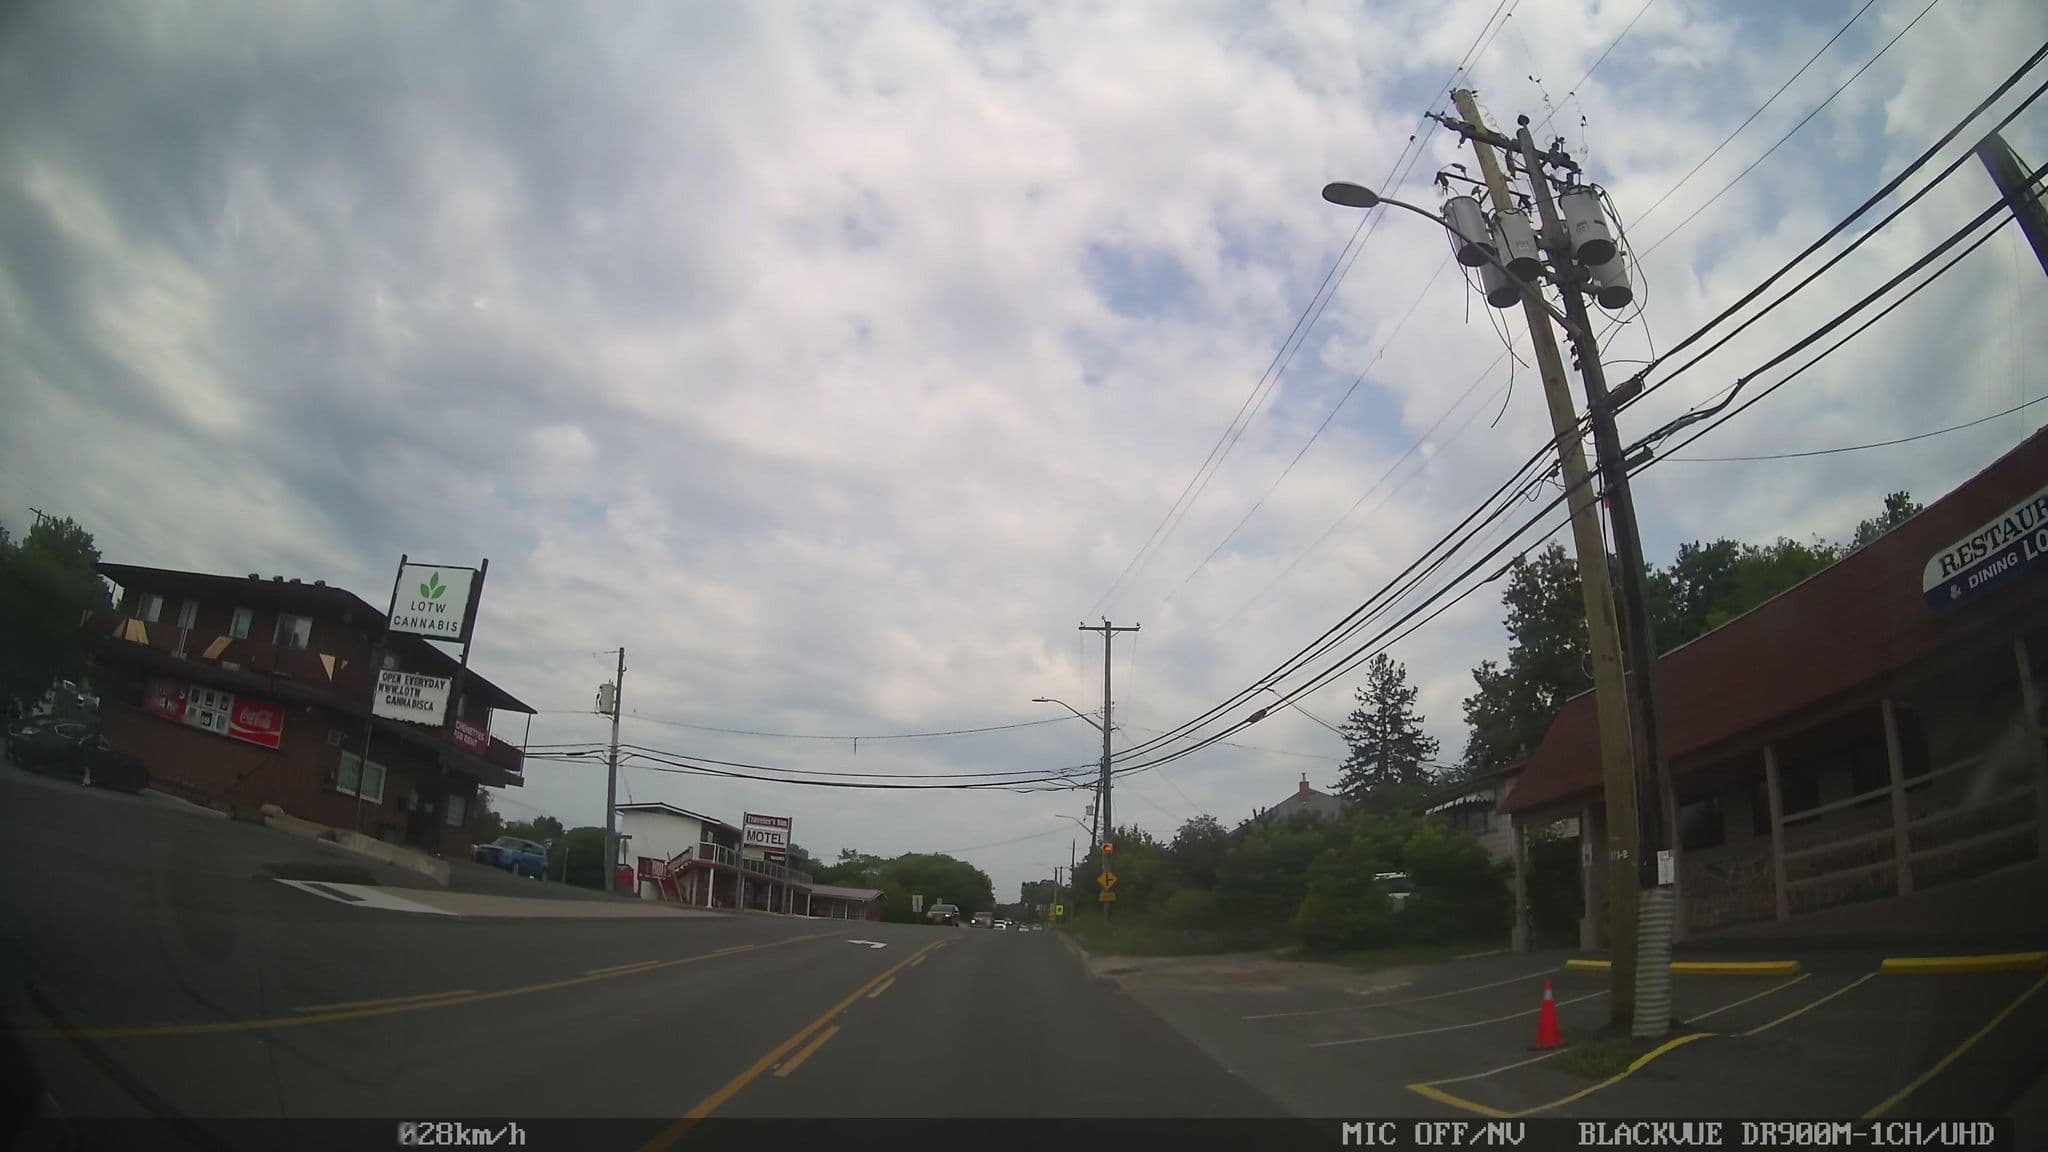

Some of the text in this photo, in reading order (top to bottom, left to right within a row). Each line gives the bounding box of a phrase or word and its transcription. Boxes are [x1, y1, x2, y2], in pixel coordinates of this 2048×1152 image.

[1950, 584, 1962, 600] &
[1968, 552, 2018, 589] DINING
[411, 601, 447, 613] LOTW
[393, 615, 459, 632] CANNABIS
[382, 672, 446, 691] OPEN EVERYDAY
[746, 830, 784, 845] MOTEL
